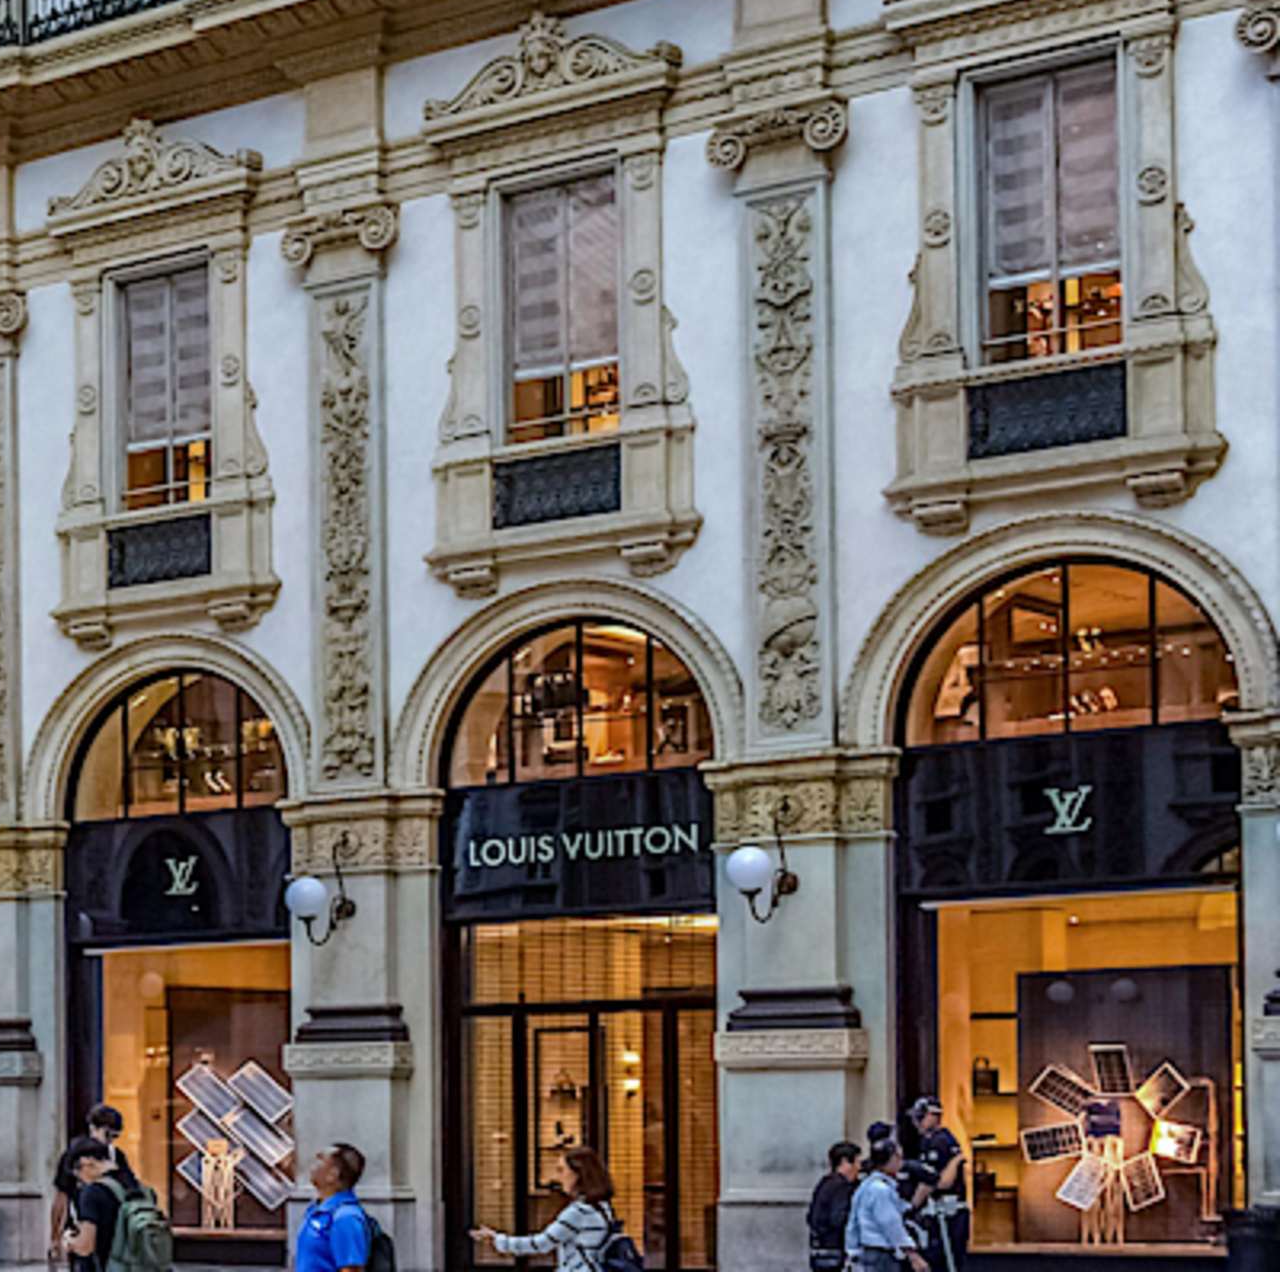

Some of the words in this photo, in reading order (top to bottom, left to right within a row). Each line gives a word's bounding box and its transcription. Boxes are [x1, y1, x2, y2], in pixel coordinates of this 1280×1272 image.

[1042, 784, 1093, 835] LV
[468, 835, 556, 867] LOUIS
[560, 823, 699, 861] VUITTON
[163, 855, 200, 896] LV
